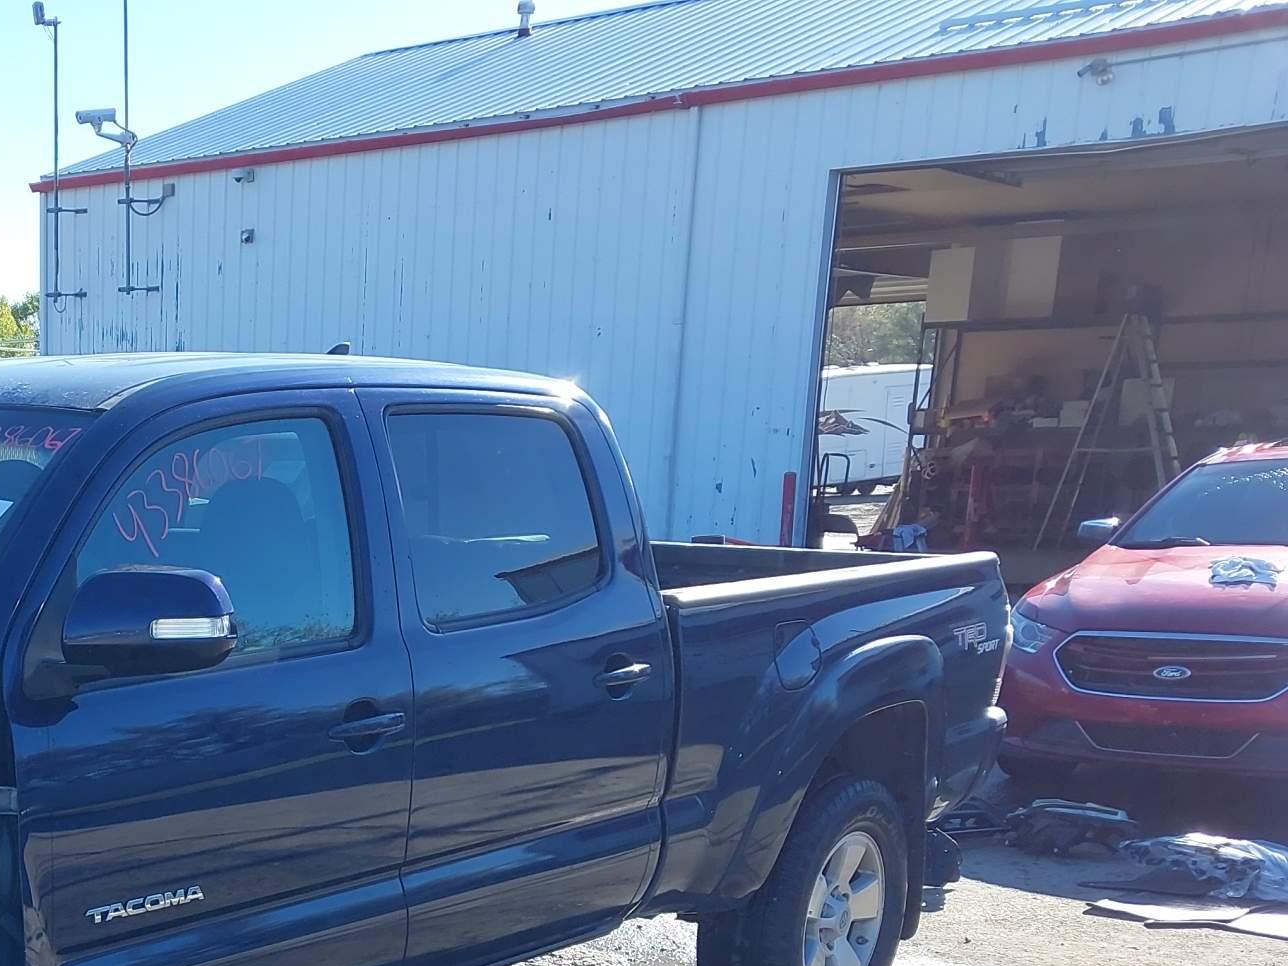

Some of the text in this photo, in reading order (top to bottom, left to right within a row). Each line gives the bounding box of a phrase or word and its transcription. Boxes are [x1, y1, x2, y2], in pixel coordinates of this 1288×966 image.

[953, 622, 987, 651] TRD
[977, 638, 1001, 655] SPORT
[85, 885, 205, 924] TACOMA
